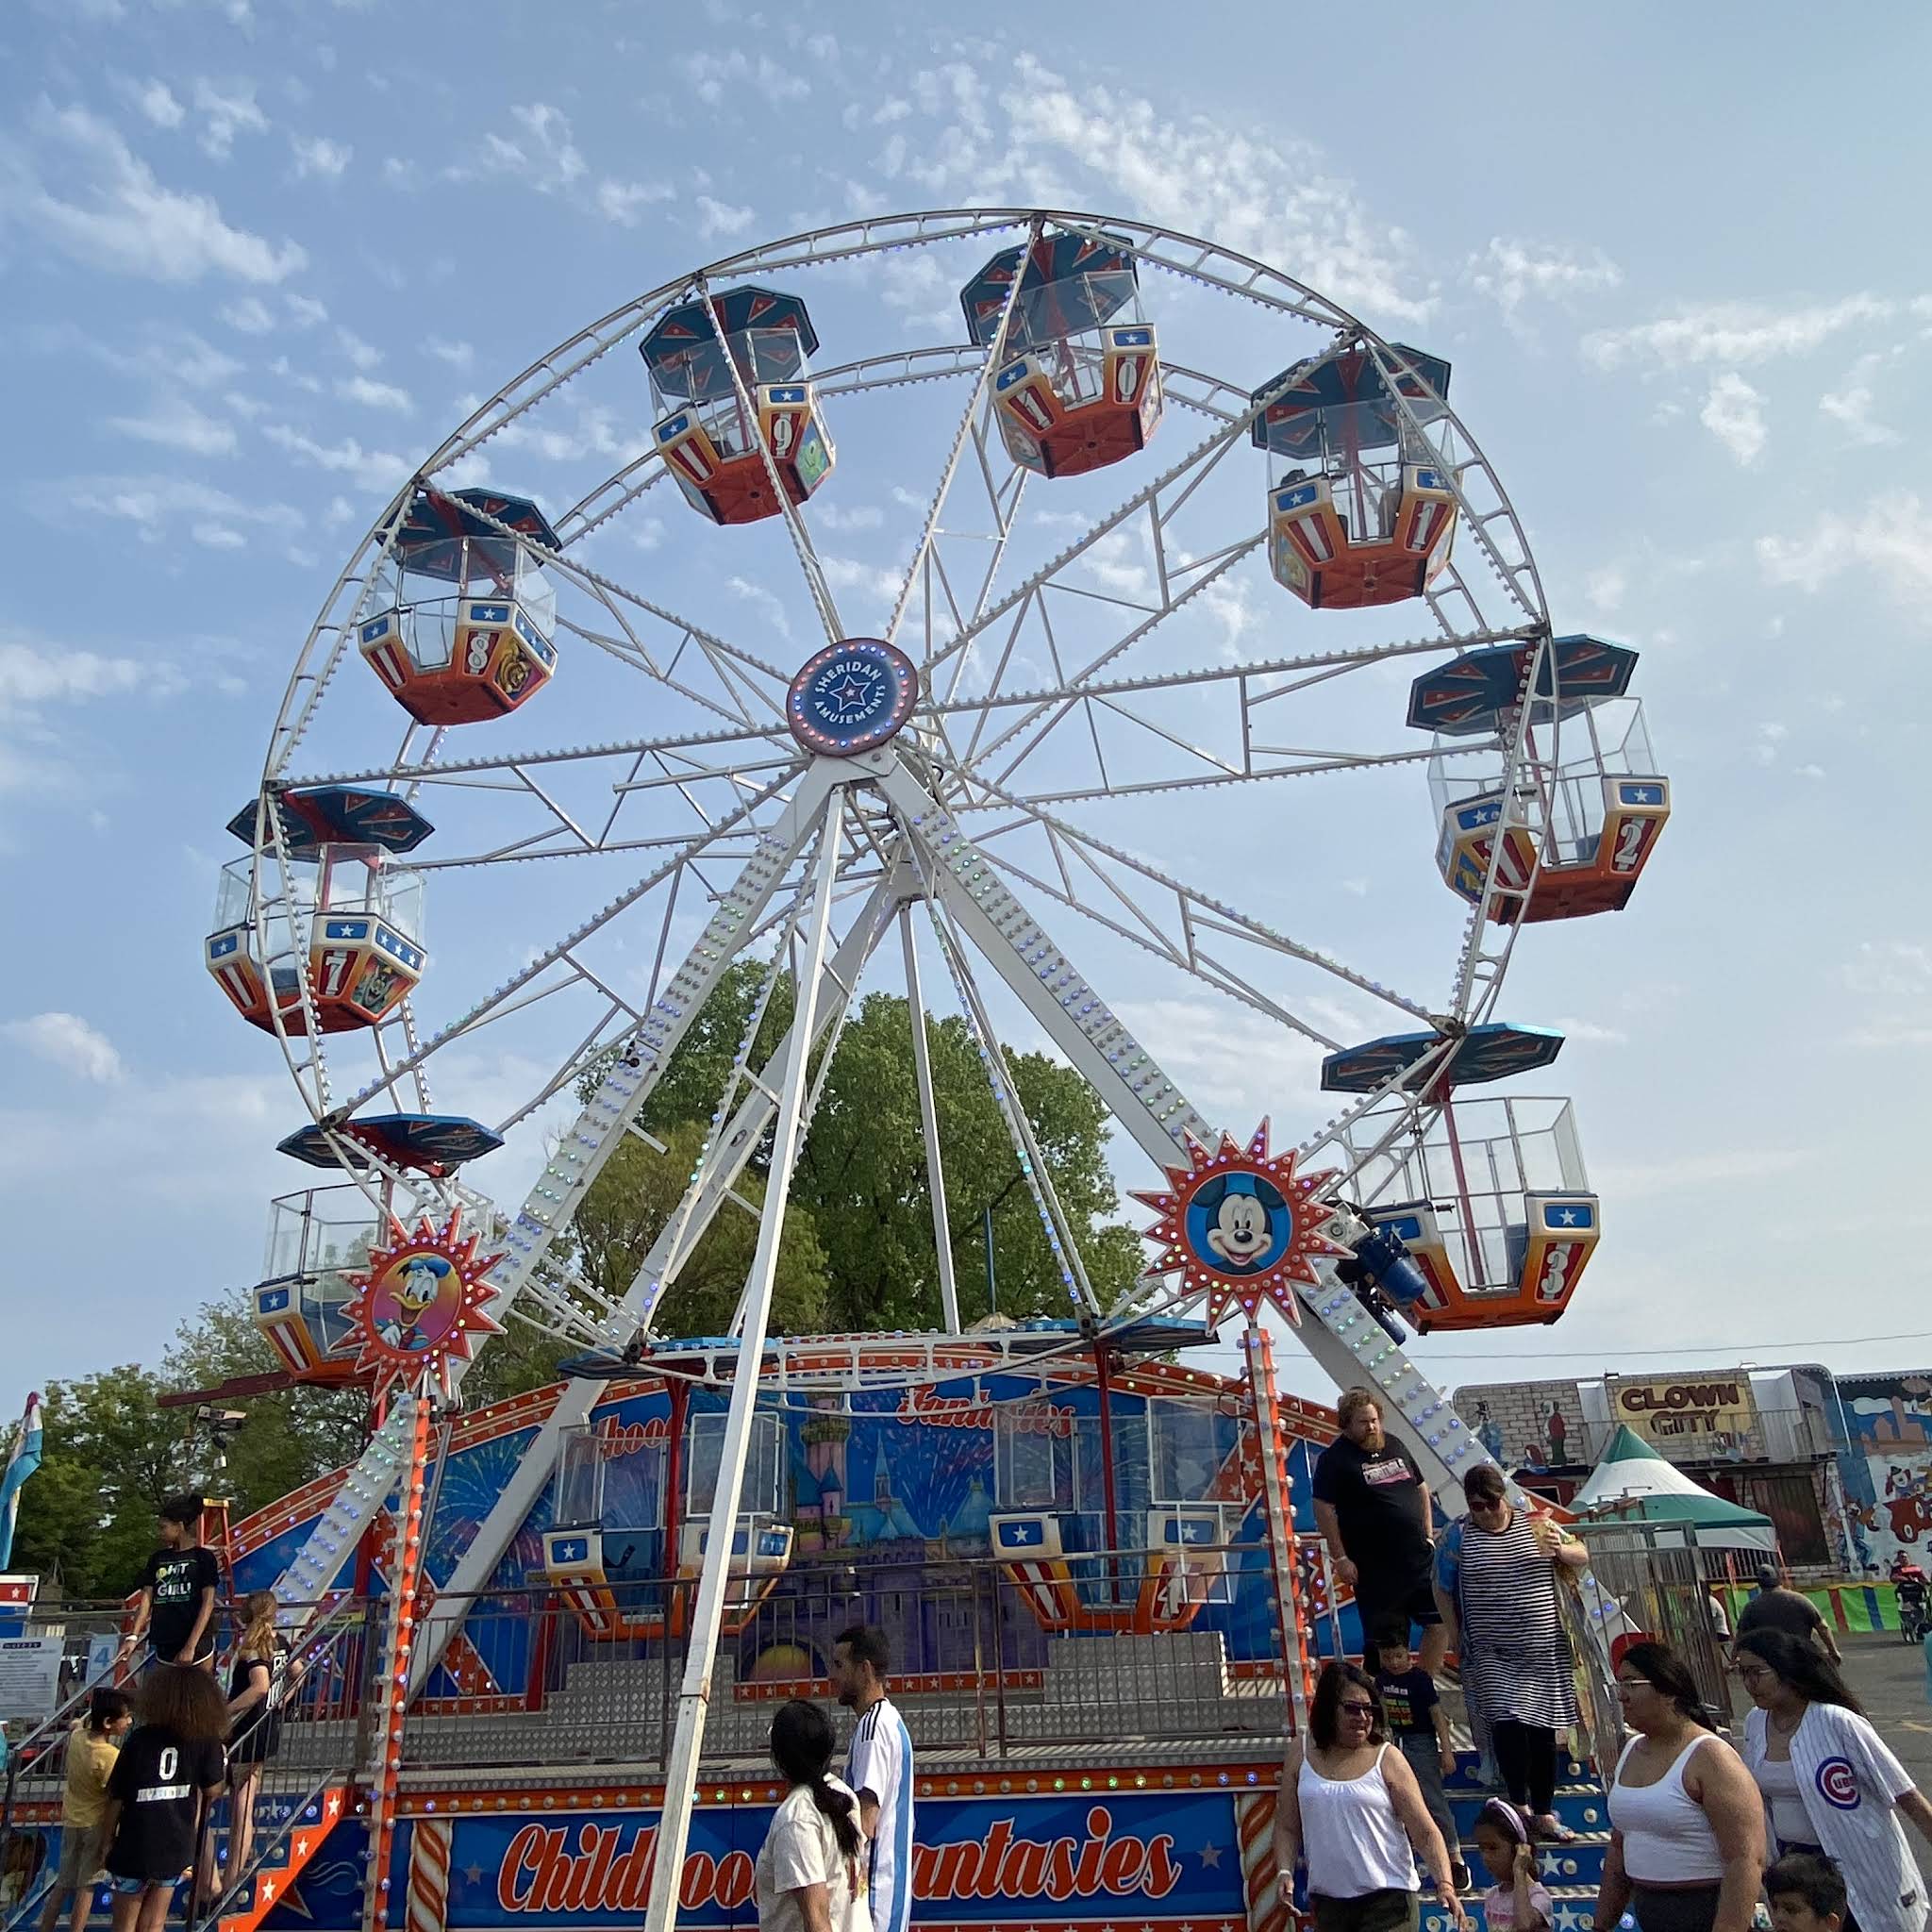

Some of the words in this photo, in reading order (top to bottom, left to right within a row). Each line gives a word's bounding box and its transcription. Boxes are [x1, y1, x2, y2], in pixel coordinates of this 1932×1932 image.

[774, 418, 792, 449] 9
[1413, 506, 1433, 545] 1
[468, 636, 489, 670] 8
[815, 661, 882, 693] SHERIDAN
[815, 685, 886, 724] AMUSEMENTS
[1614, 823, 1642, 865] 2
[325, 957, 347, 995] 7
[1541, 1250, 1569, 1293] 3
[1622, 1384, 1740, 1411] CLOWN
[1651, 1409, 1720, 1435] CITY
[1158, 1563, 1187, 1615] 4
[94, 1646, 109, 1668] 4
[158, 1747, 178, 1780] 0
[498, 1823, 758, 1912] Childoo
[911, 1806, 1183, 1901] antasies
